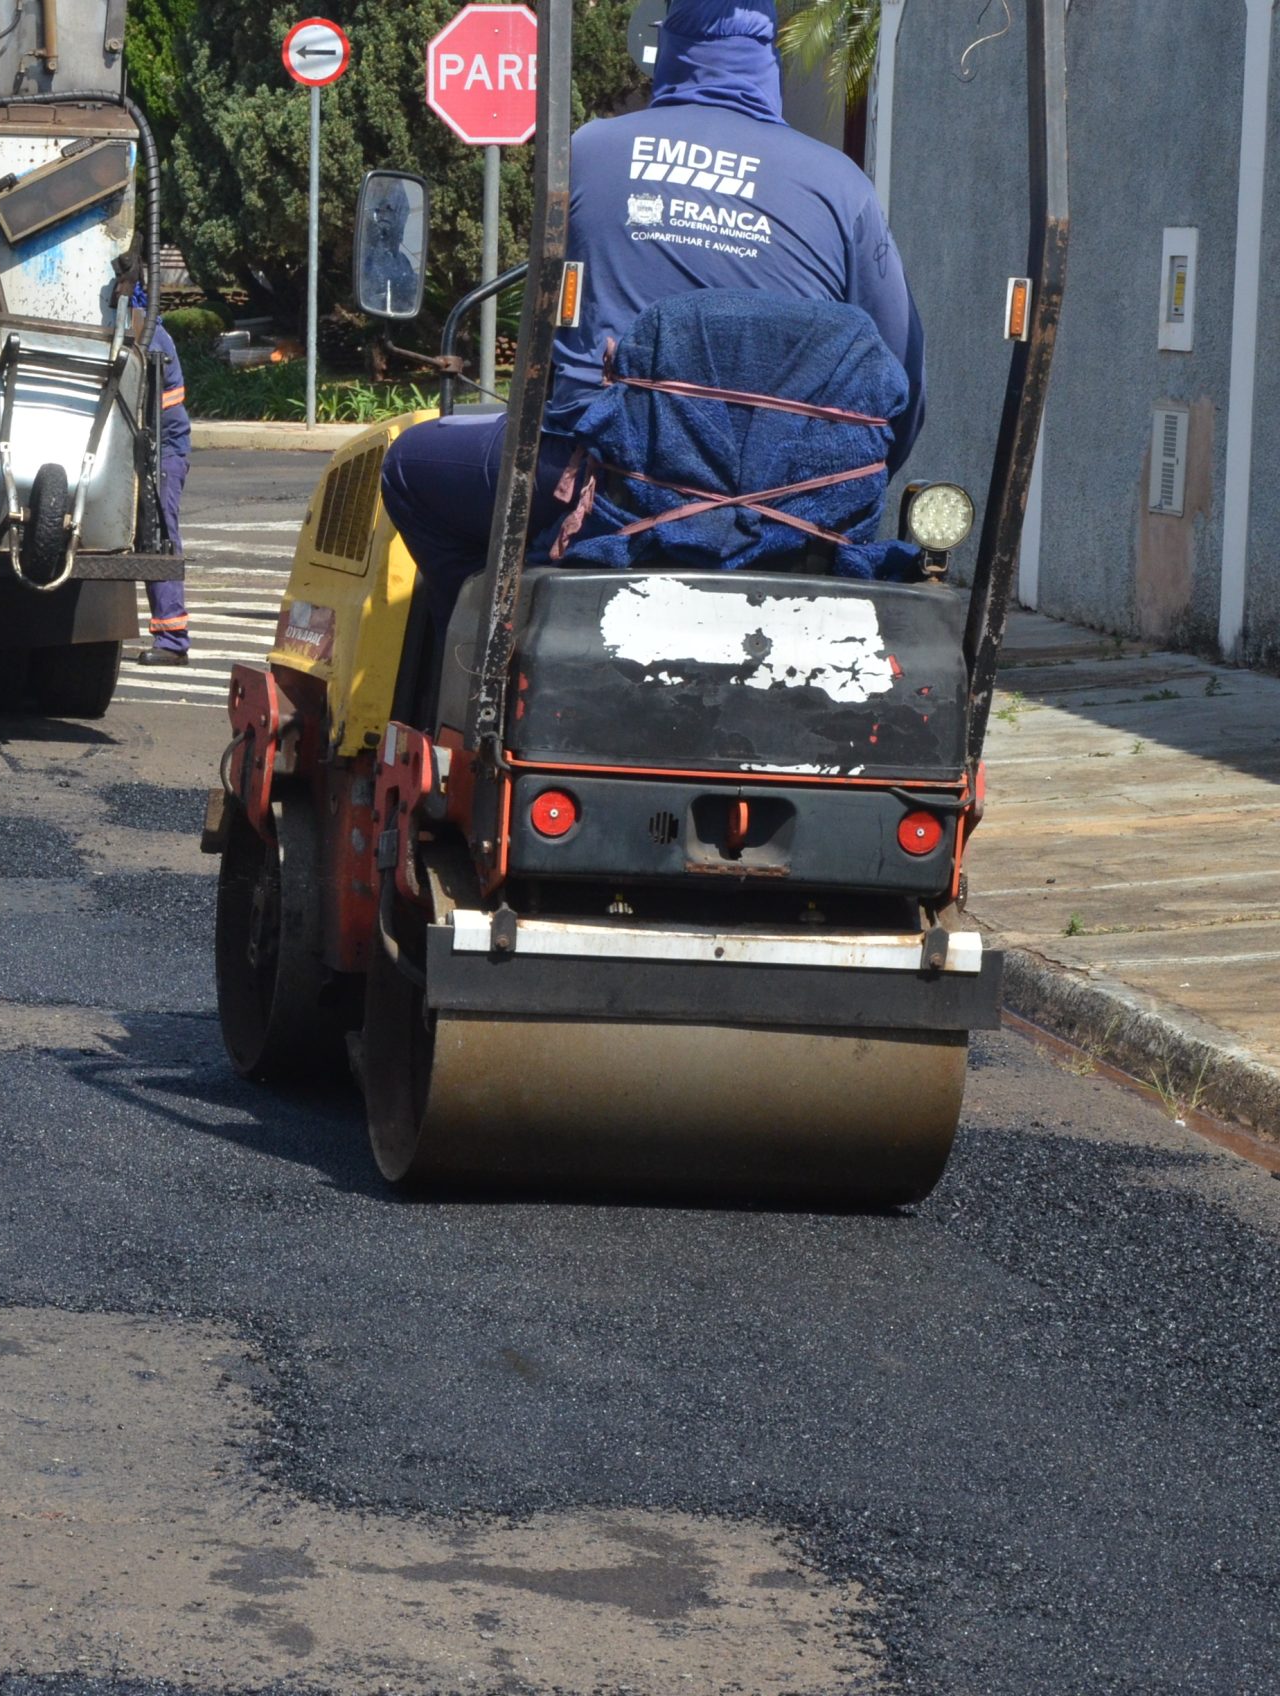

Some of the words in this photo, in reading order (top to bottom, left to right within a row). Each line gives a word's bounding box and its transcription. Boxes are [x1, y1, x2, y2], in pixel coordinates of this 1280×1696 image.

[632, 136, 761, 179] EMDEF
[669, 198, 772, 235] FRANCA
[669, 217, 718, 234] GOVERNO
[719, 227, 771, 245] MUNICIPAL
[631, 231, 703, 247] COMPARTILHAR
[704, 239, 711, 249] E
[712, 242, 758, 258] AVANÇAR
